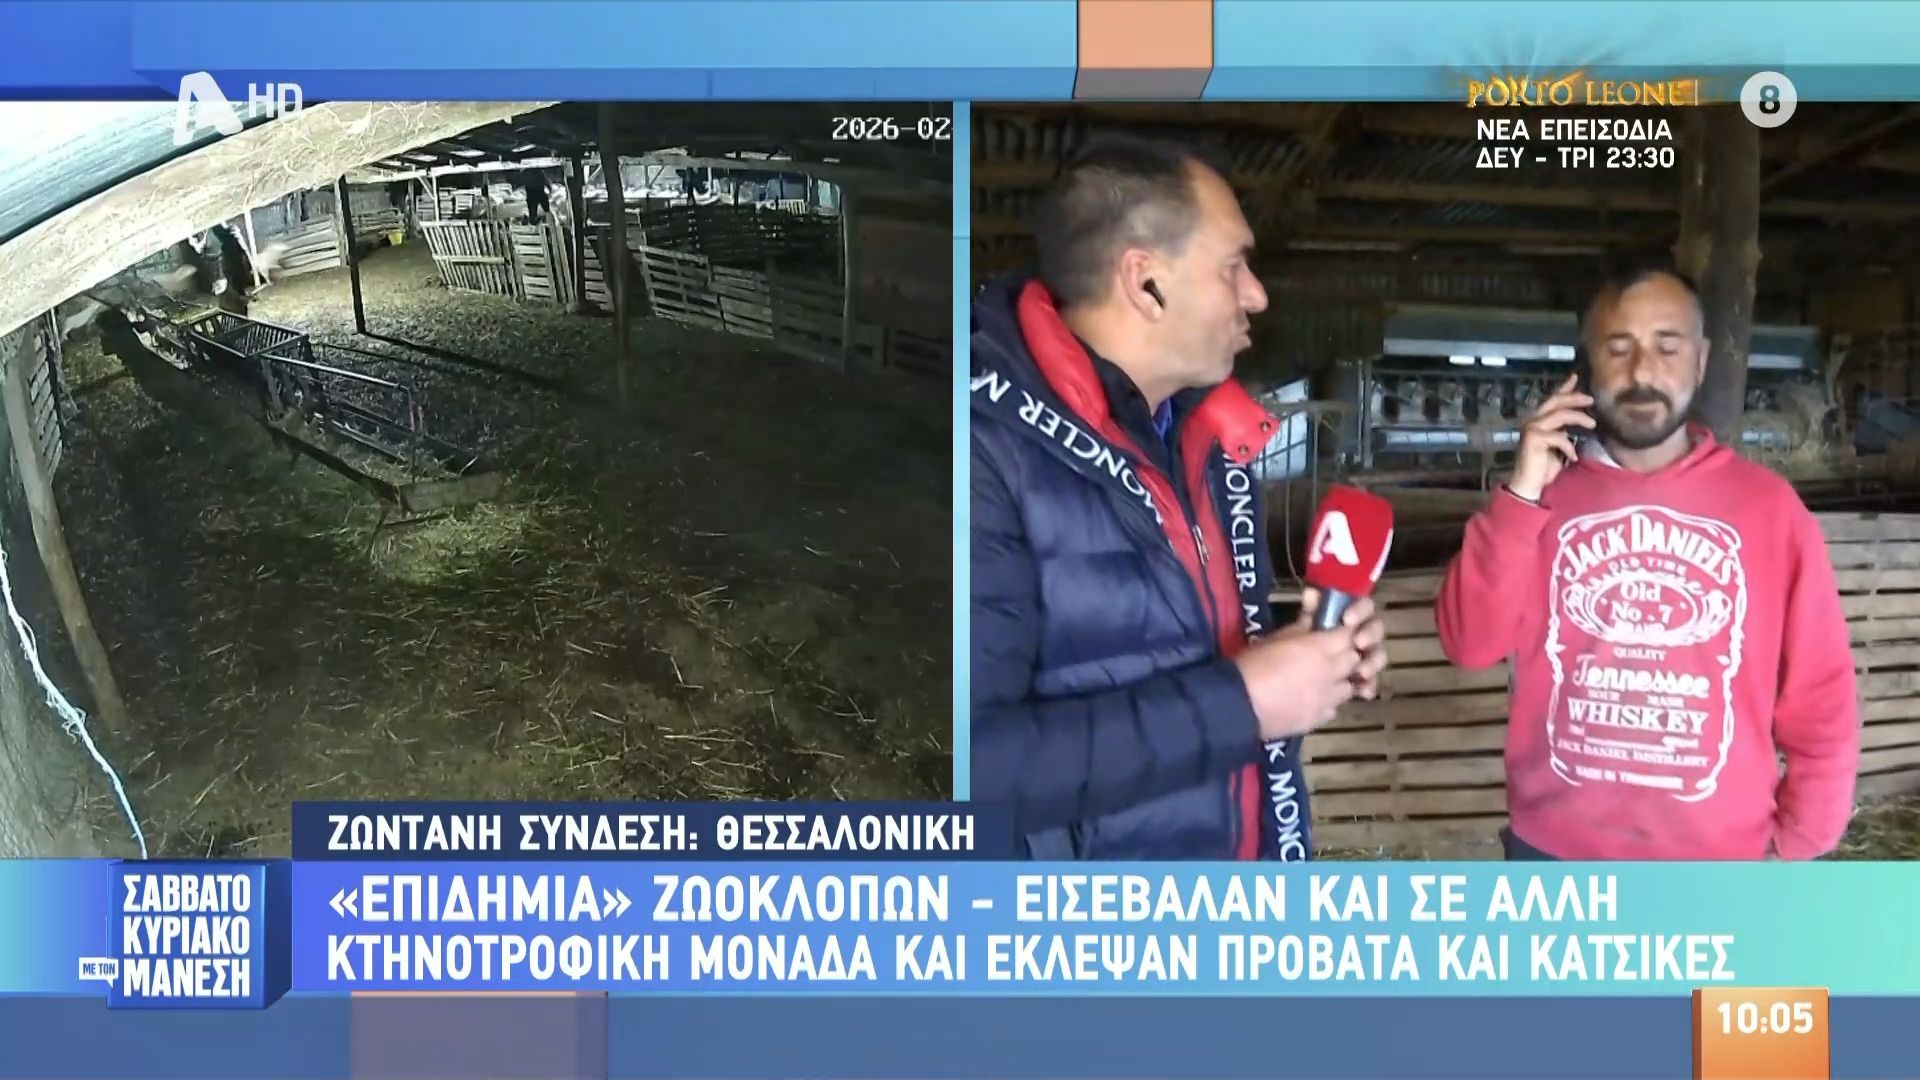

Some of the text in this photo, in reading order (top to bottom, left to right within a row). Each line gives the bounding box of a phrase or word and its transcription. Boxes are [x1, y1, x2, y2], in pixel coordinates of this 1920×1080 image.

[1563, 524, 1631, 582] JACK
[1620, 581, 1662, 603] Old
[1572, 654, 1711, 698] Tennessee
[1567, 697, 1710, 736] WHISKEY
